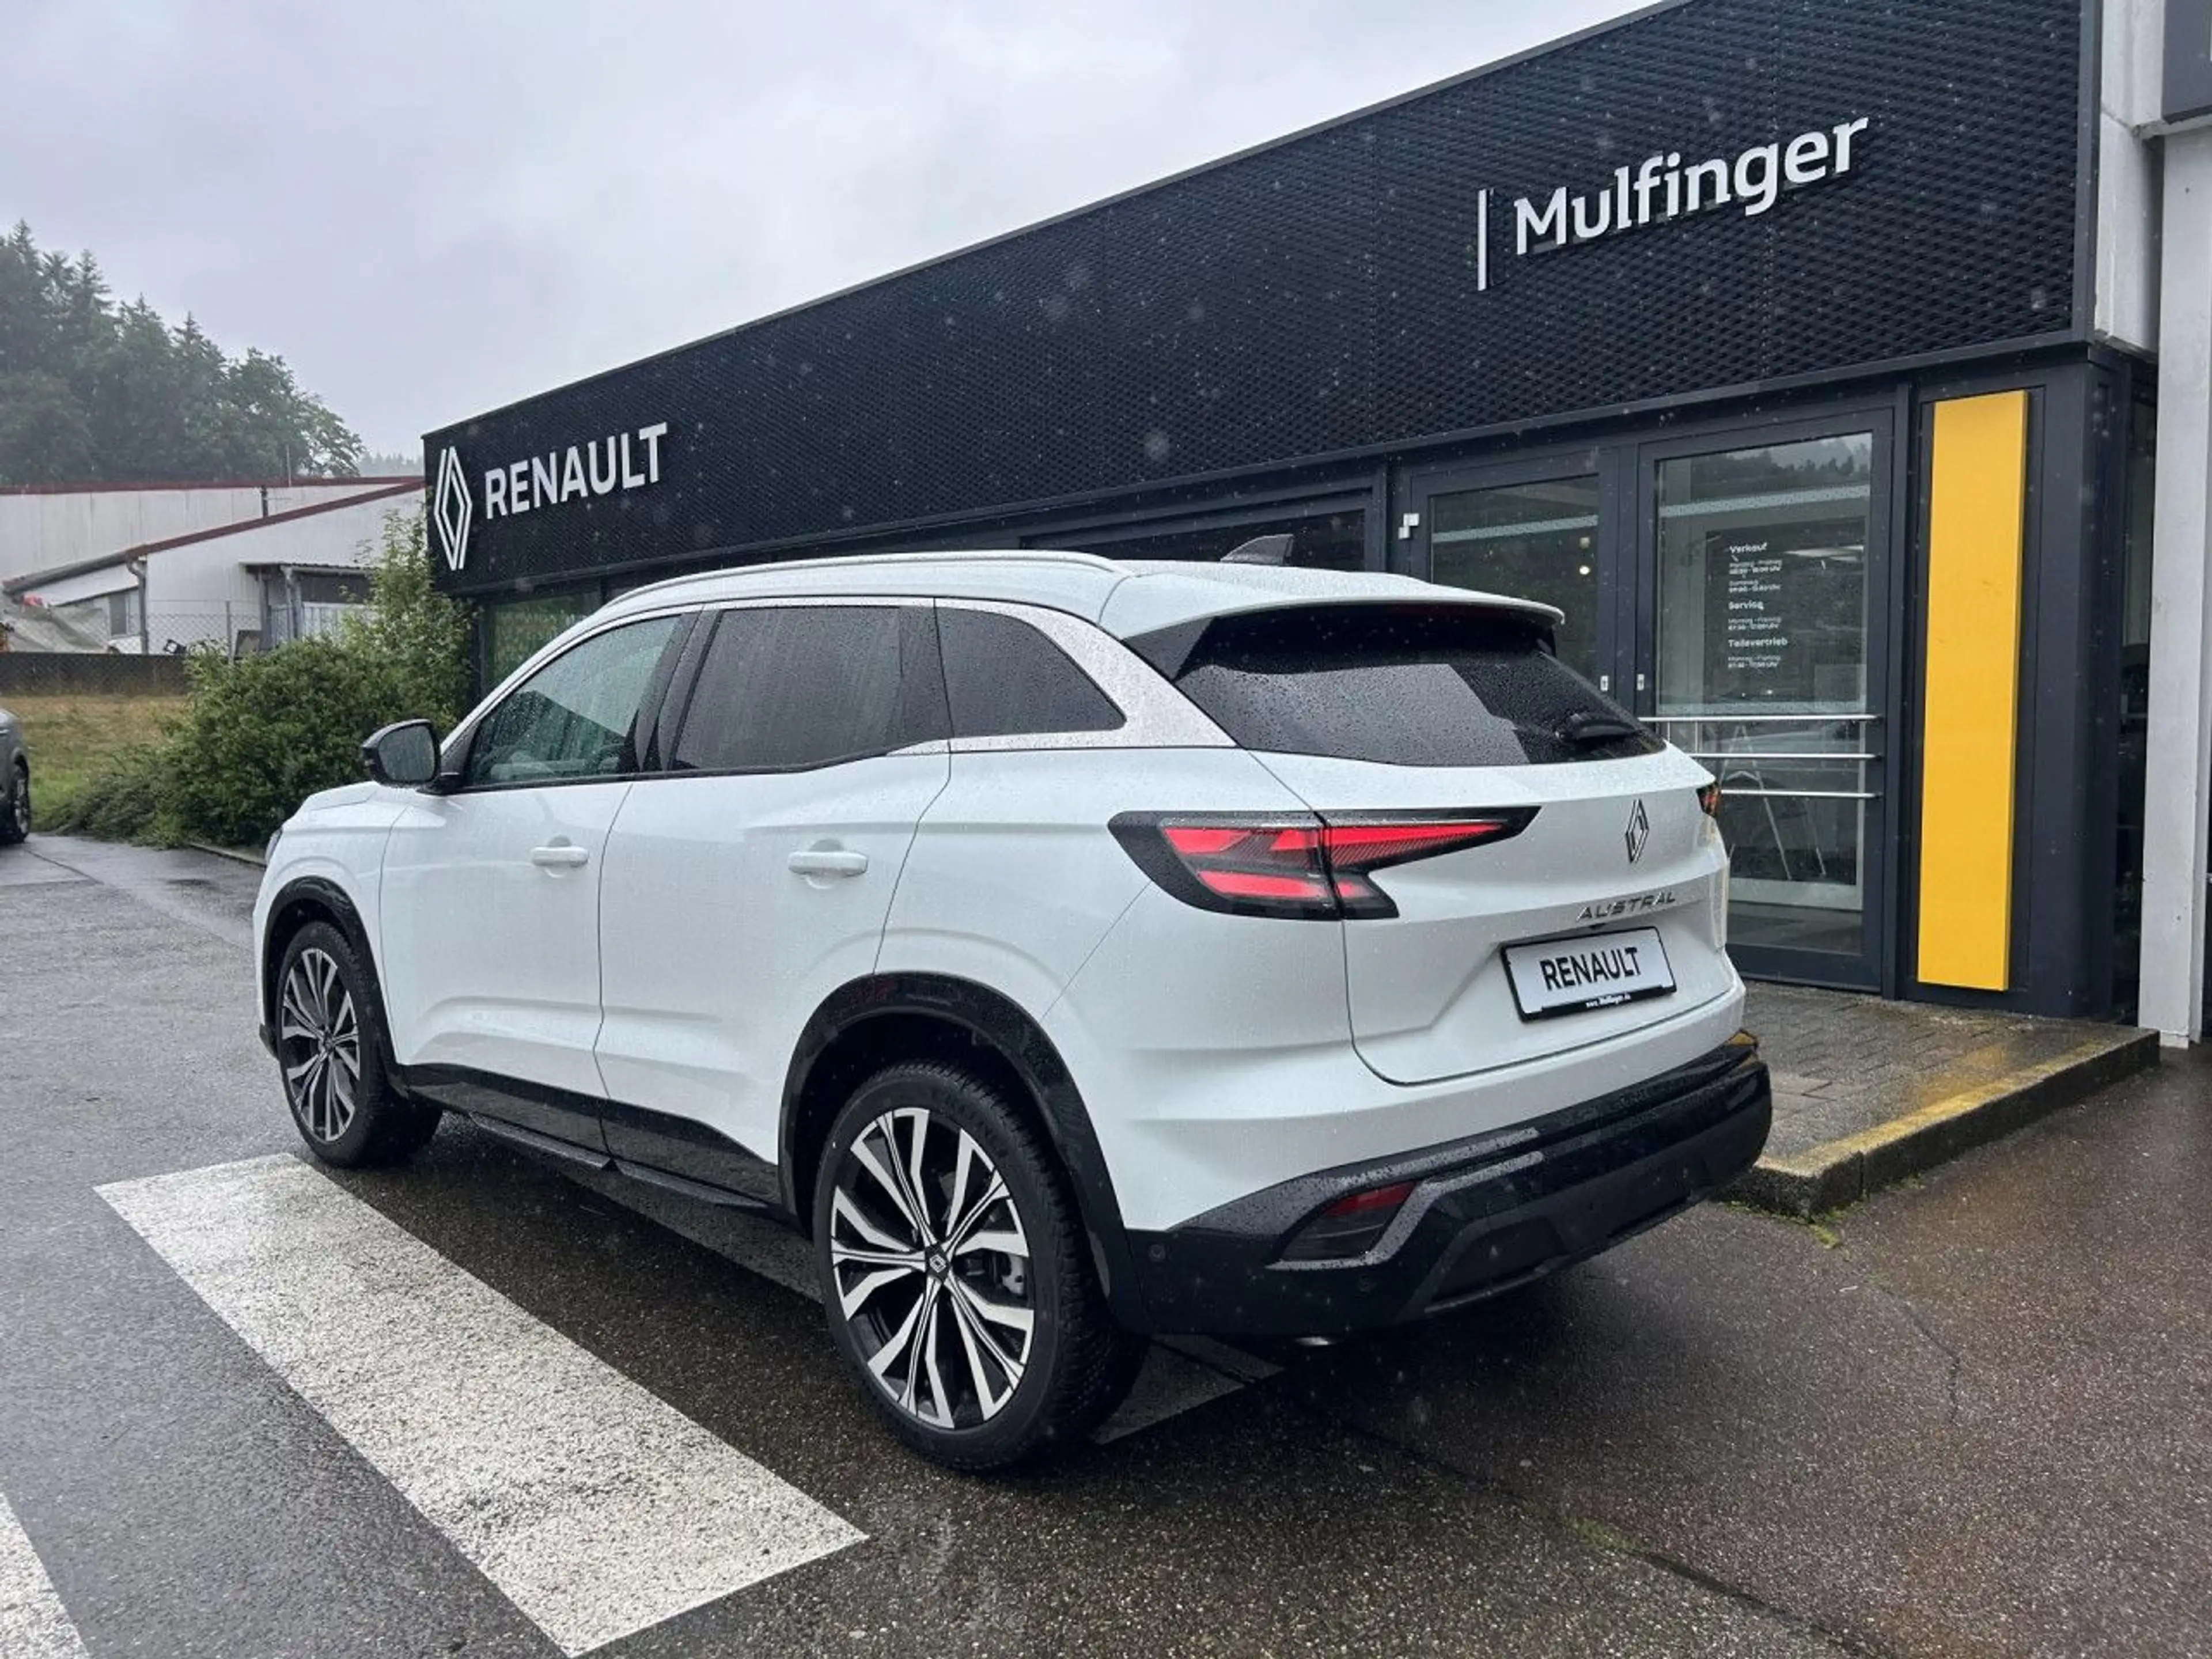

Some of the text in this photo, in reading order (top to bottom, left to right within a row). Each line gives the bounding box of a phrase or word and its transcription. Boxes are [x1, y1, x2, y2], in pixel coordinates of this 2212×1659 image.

[1513, 117, 1869, 255] Mulfinger
[484, 422, 668, 519] RENAULT
[1575, 891, 1676, 923] AUSTRAL
[1539, 947, 1641, 991] RENAULT
